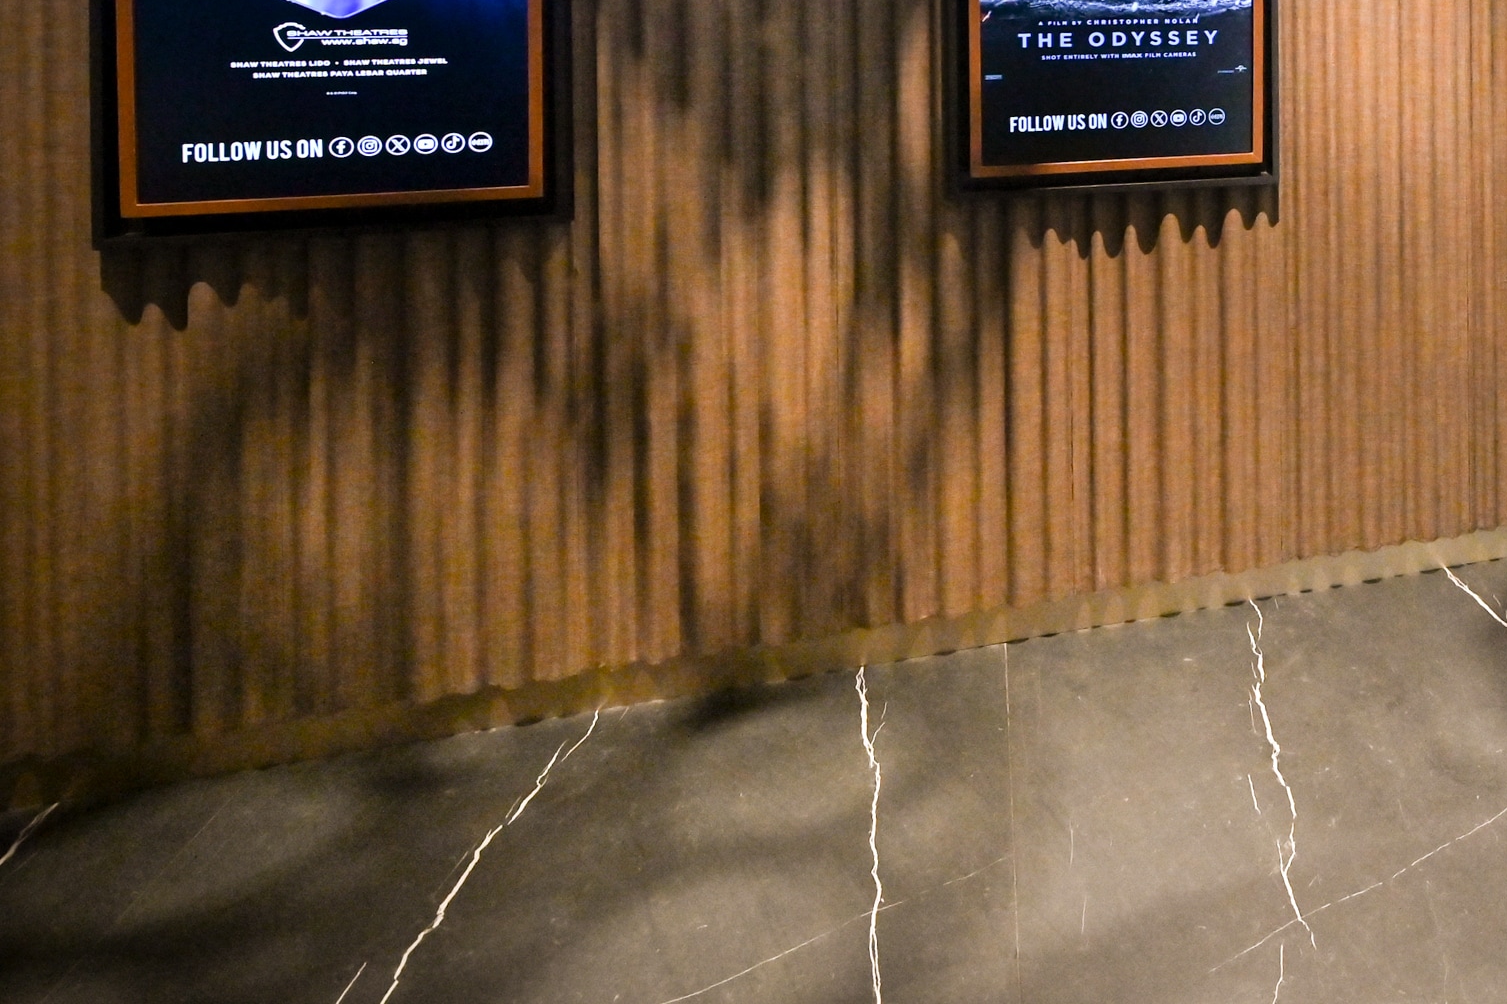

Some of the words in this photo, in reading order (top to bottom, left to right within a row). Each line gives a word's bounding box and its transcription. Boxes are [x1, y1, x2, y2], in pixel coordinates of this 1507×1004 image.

[1086, 18, 1159, 26] CHRISTOPHER
[286, 29, 333, 37] SHAW
[334, 28, 408, 36] THEATRES
[321, 37, 408, 46] www.shaw.sg
[1017, 32, 1073, 48] THE
[1088, 29, 1218, 47] ODYSSEY
[230, 61, 258, 69] SHAW
[260, 60, 307, 68] THEATRES
[308, 59, 331, 67] LIDO
[343, 59, 370, 67] SHAW
[371, 58, 416, 66] THEATRES
[417, 57, 448, 65] JEWEL
[281, 70, 328, 78] THEATRES
[329, 70, 354, 78] PAYA
[355, 69, 384, 77] LEBAR
[385, 68, 427, 77] QUARTER
[1009, 114, 1065, 133] FOLLOW
[1067, 113, 1086, 131] US
[1088, 113, 1107, 130] ON
[182, 141, 261, 163] FOLLOW
[266, 140, 292, 160] US
[296, 138, 323, 159] ON
